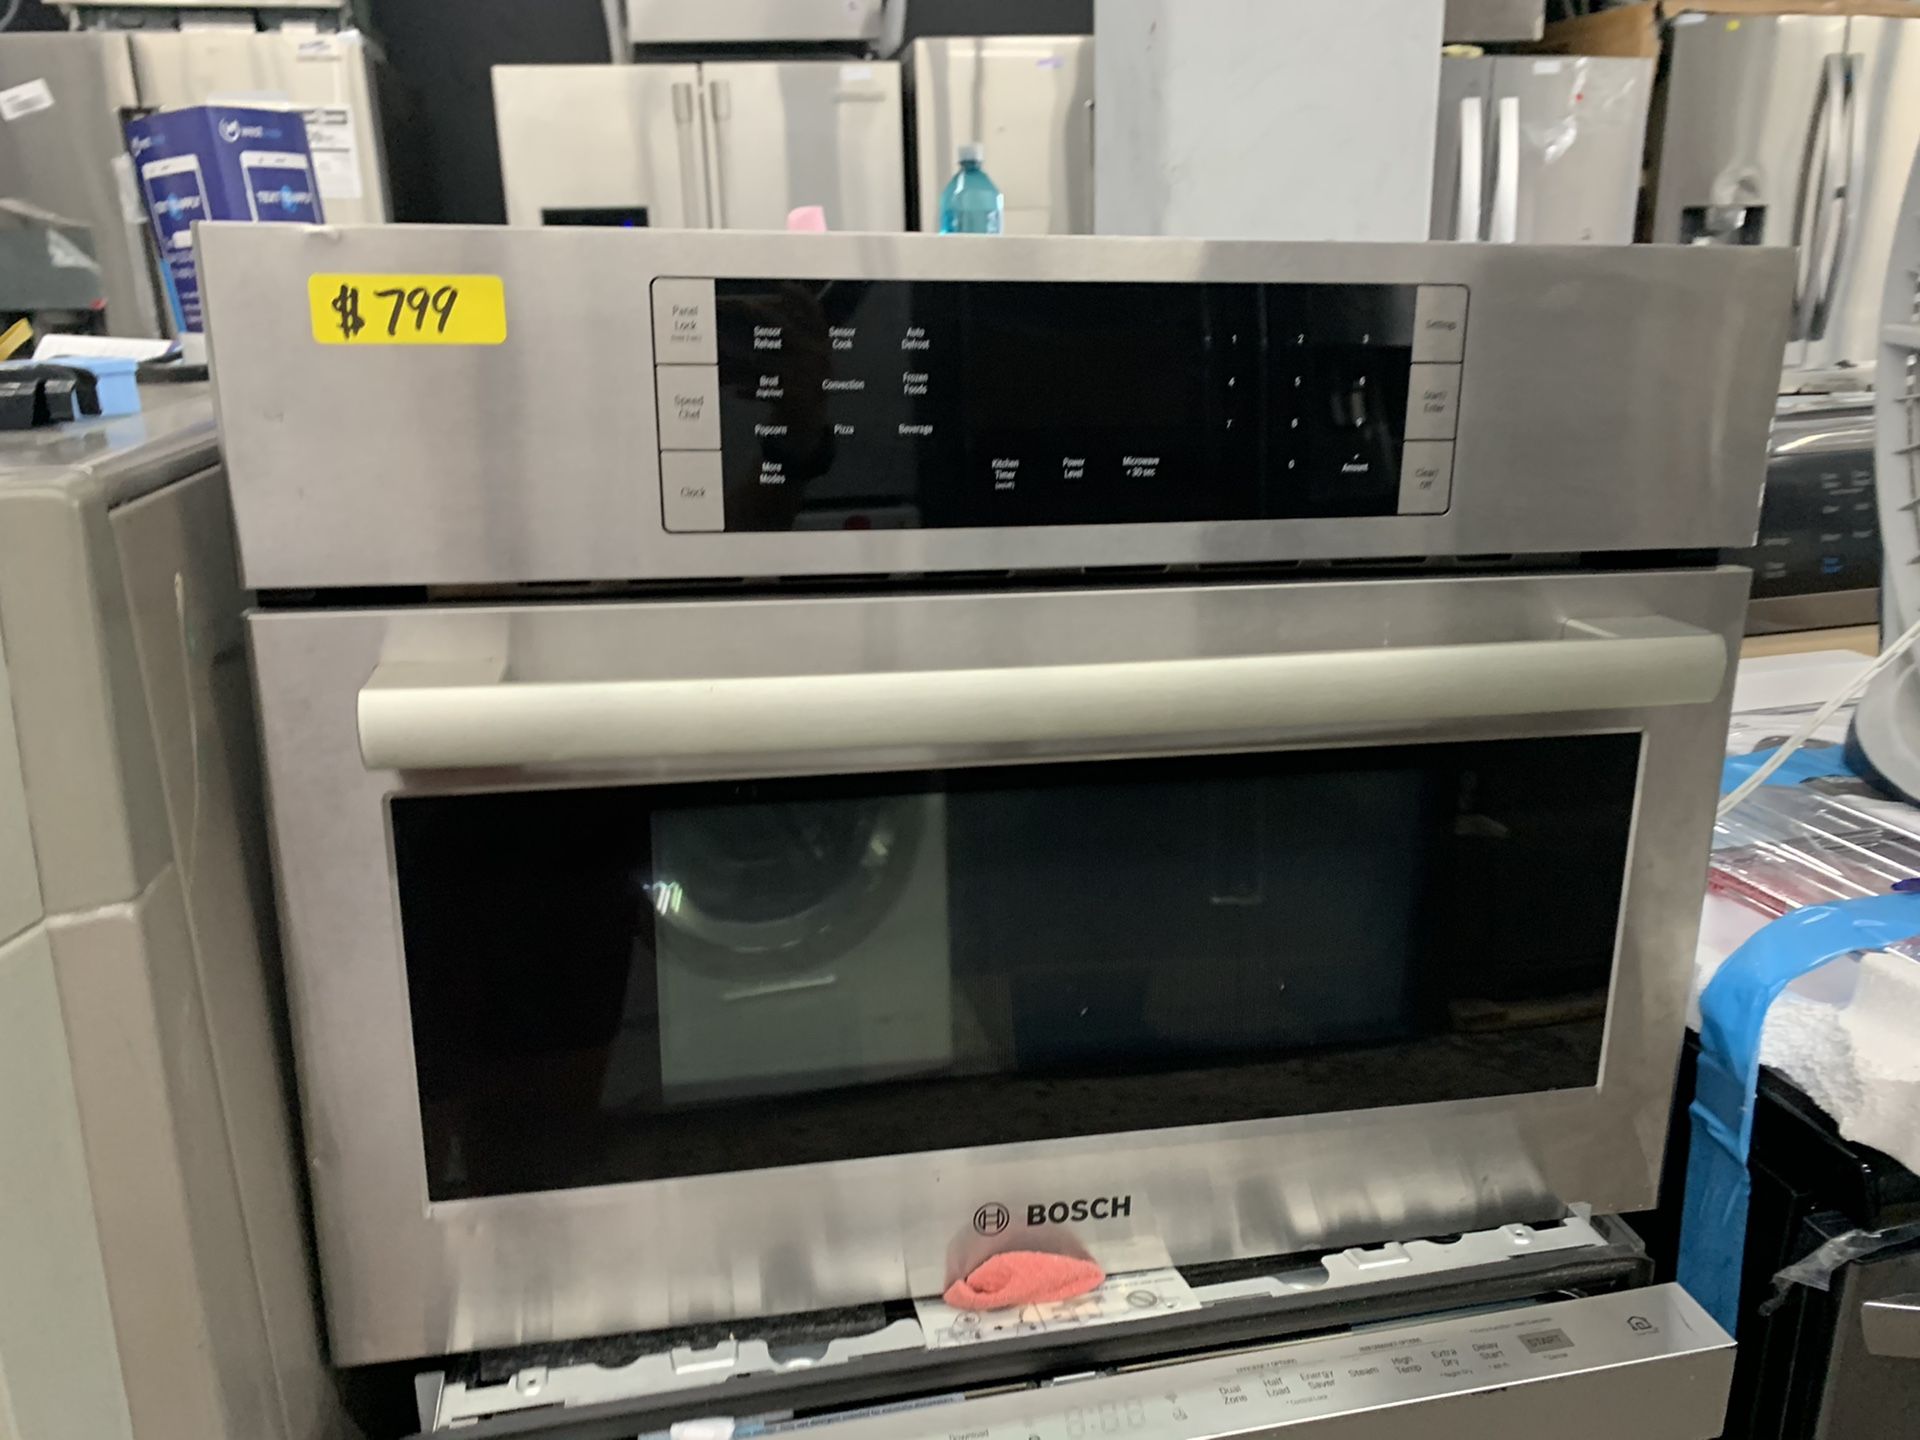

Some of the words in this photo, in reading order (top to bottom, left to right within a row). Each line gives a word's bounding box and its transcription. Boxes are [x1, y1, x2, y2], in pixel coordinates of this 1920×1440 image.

[332, 284, 366, 339] $
[373, 285, 458, 337] 799
[754, 325, 782, 337] Sensor
[828, 325, 856, 337] Sensor
[906, 327, 926, 338] Auto
[832, 338, 854, 349] Cook
[901, 338, 930, 350] Defrost
[1232, 334, 1237, 344] 1
[1297, 333, 1305, 344] 2
[903, 372, 928, 383] Frozen
[1228, 376, 1235, 387] 4
[822, 379, 865, 391] Convection
[904, 384, 928, 395] Foods
[754, 424, 788, 436] Popcorn
[834, 424, 855, 434] Pizza
[899, 423, 934, 436] Beverage
[762, 461, 783, 472] More
[991, 458, 1019, 469] Kitchen
[1062, 456, 1085, 468] Power
[1122, 456, 1160, 467] Microwave
[1064, 468, 1083, 479] Level
[1342, 463, 1369, 473] Amount
[760, 473, 786, 484] Modes
[995, 470, 1016, 480] Timer
[1027, 1195, 1131, 1227] BOSCH
[1527, 1334, 1563, 1347] START
